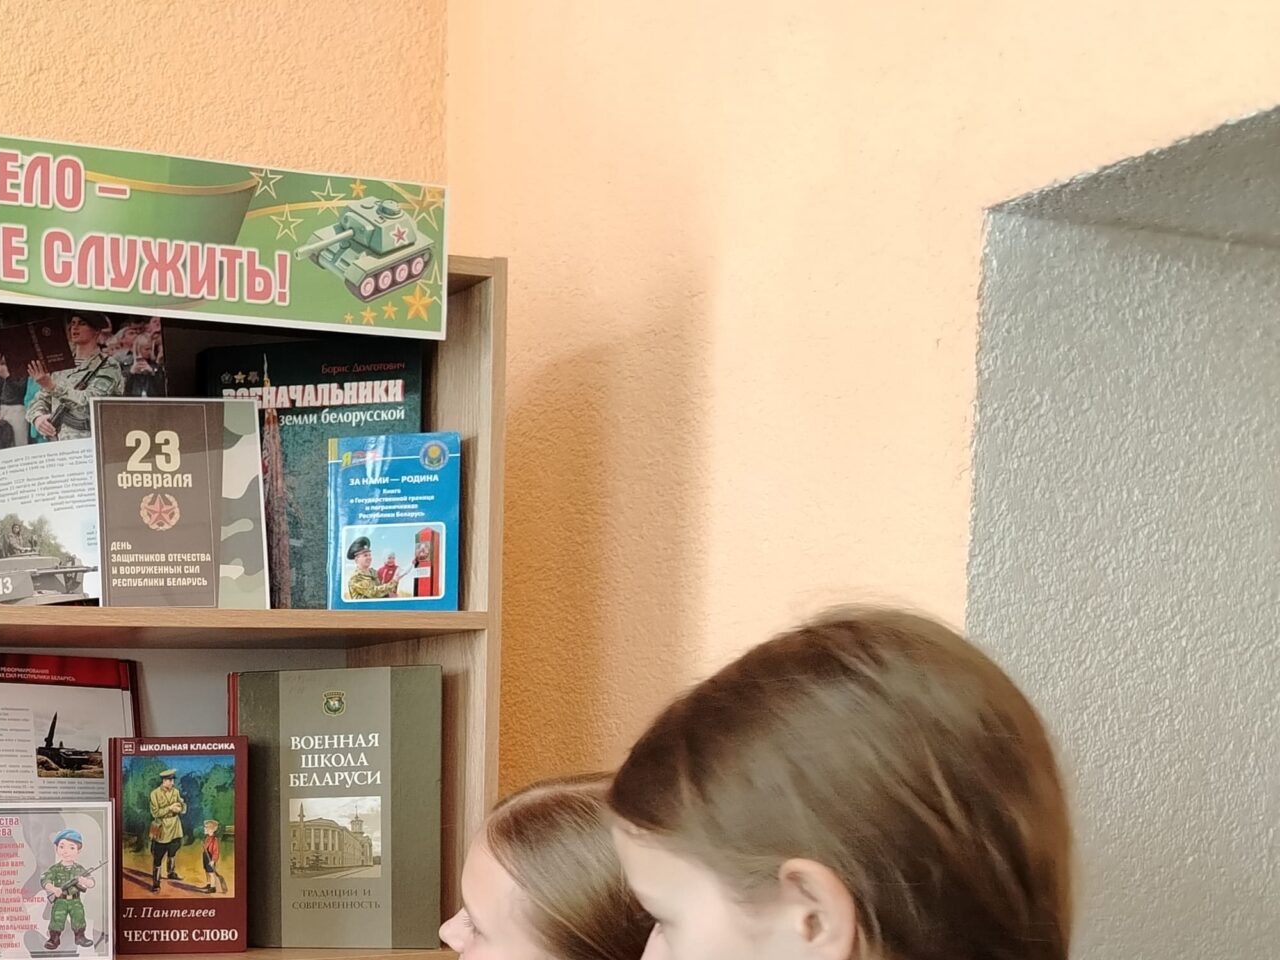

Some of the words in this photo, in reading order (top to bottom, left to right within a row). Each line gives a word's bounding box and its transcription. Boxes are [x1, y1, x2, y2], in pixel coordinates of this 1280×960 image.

[42, 228, 290, 305] СЛУЖИТЬ!
[321, 362, 350, 375] Борис
[352, 360, 405, 375] Долготович
[279, 413, 318, 427] земли
[320, 407, 405, 427] белорусской
[125, 430, 181, 472] 23
[117, 471, 192, 491] февраля
[349, 478, 361, 486] ЗА
[401, 474, 439, 483] РОДИНА
[111, 541, 132, 552] ДЕНЬ
[111, 552, 166, 565] ЗАЩИТНИКОВ
[167, 552, 211, 563] ОТЕЧЕСТВА
[112, 565, 118, 575] И
[119, 564, 182, 575] ВООРУЖЕННЫХ
[183, 564, 200, 574] СИЛ
[112, 577, 165, 588] РЕСПУБЛИКИ
[166, 576, 208, 587] БЕЛАРУСЬ
[140, 742, 188, 751] ШКОЛЬНАЯ
[190, 742, 235, 751] КЛАССИКА
[290, 733, 380, 750] ВОЕННАЯ
[300, 753, 369, 768] ШКОЛА
[289, 771, 382, 788] БЕЛАРУСИ
[302, 889, 357, 897] ТРАДИЦИИ
[292, 901, 380, 909] СОВРЕМЕННОСТЬ
[123, 908, 137, 918] Л.
[141, 907, 216, 918] Пантелеев
[123, 929, 189, 942] ЧЕСТНОЕ
[192, 928, 238, 942] СЛОВО
